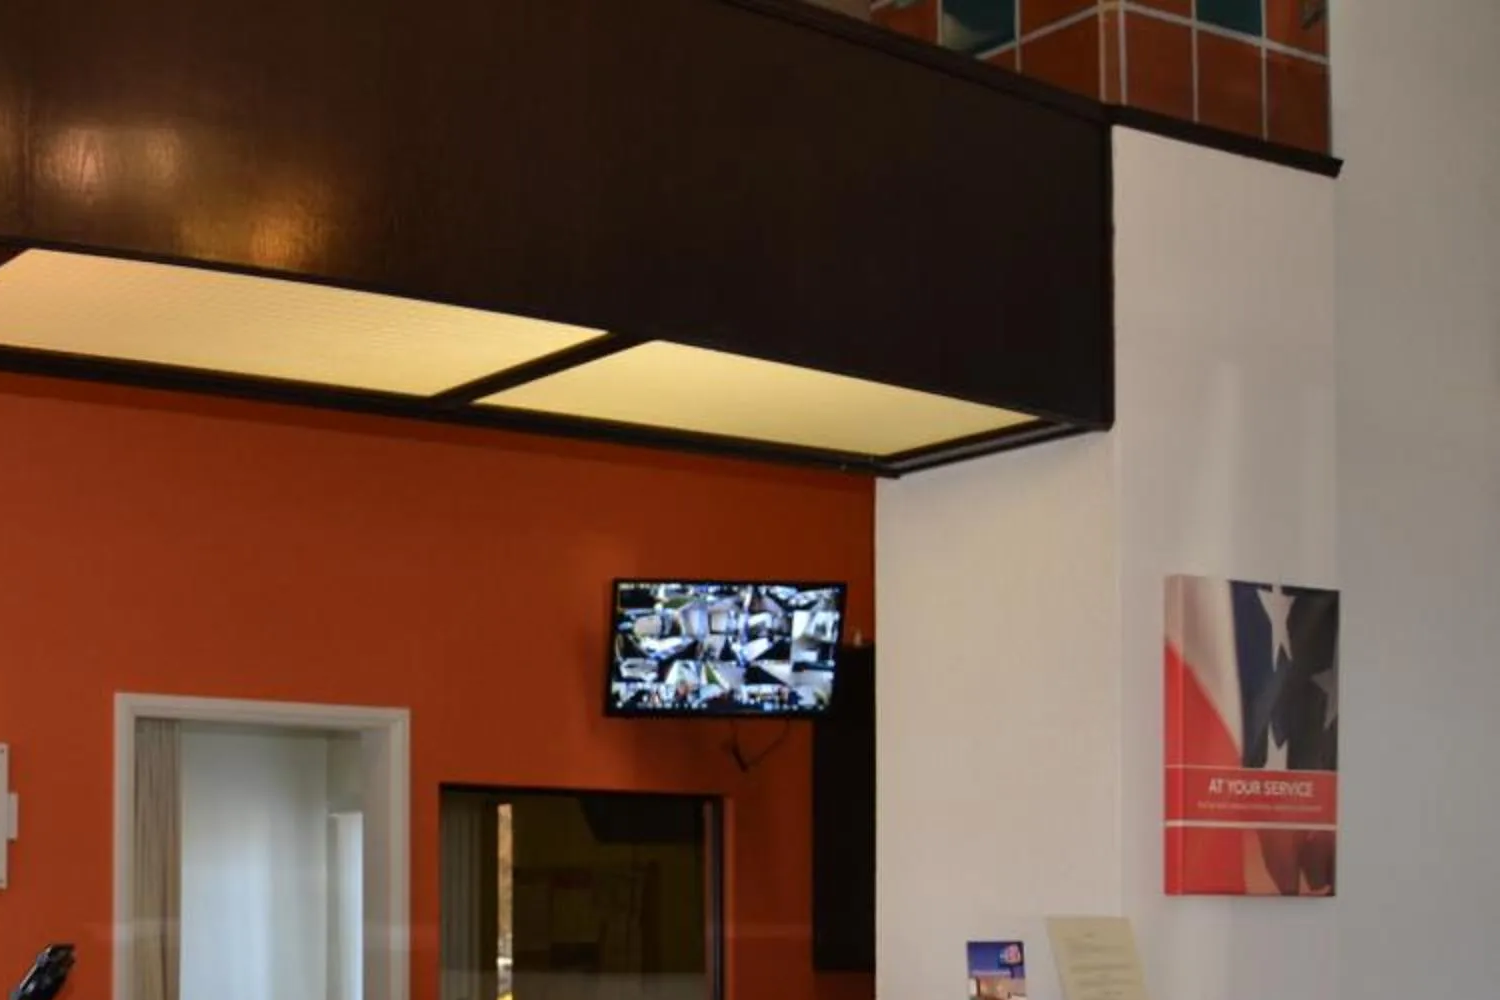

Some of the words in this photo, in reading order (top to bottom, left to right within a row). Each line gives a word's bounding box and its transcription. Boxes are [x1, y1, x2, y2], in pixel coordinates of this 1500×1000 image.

[1208, 778, 1223, 795] AT
[1226, 779, 1261, 797] YOUR
[1263, 780, 1314, 798] SERVICE
